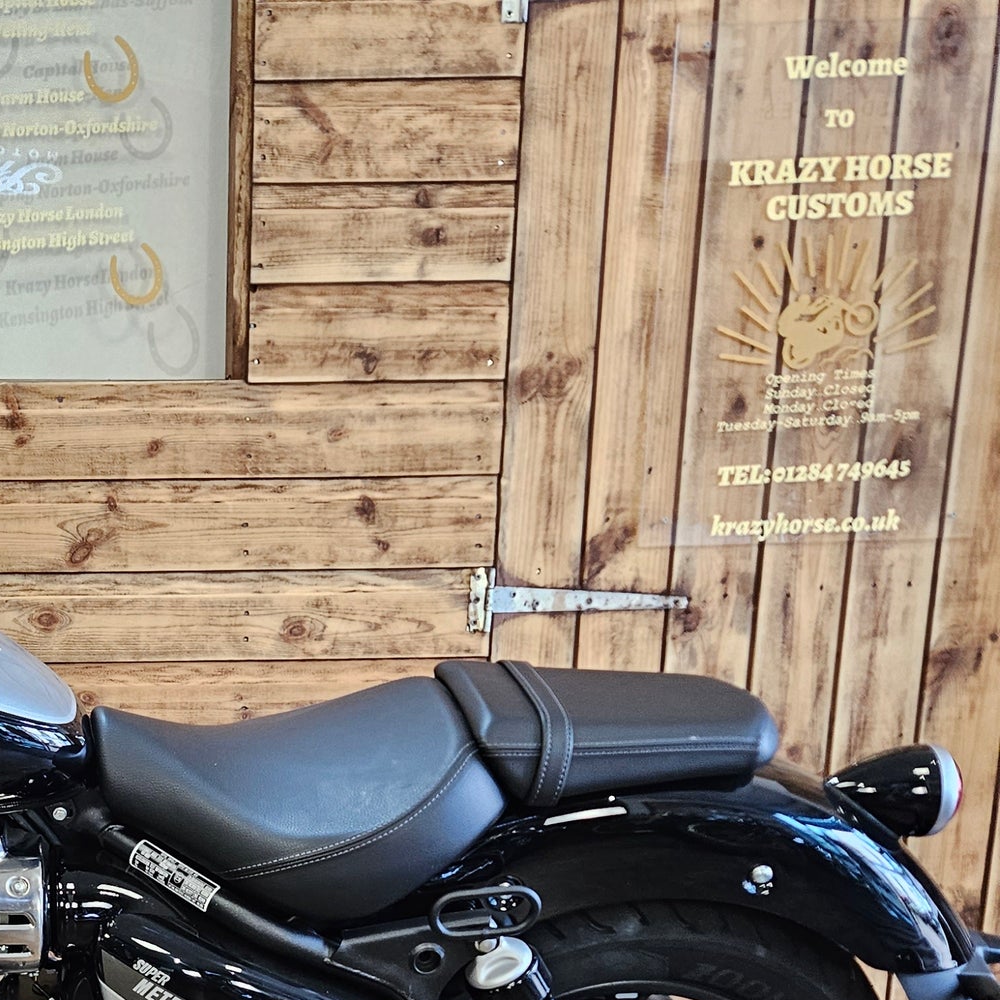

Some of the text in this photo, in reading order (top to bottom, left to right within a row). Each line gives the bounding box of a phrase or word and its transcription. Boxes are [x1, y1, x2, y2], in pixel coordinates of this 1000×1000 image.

[785, 51, 908, 80] Welcome
[36, 86, 86, 105] House
[2, 117, 159, 138] Norton-Oxfordshire
[824, 108, 855, 128] TO
[728, 152, 953, 187] KRAZY HORSE
[17, 208, 64, 223] Horse
[65, 203, 124, 221] London
[766, 190, 915, 221] CUSTOMS
[49, 231, 88, 252] High
[89, 228, 136, 246] Street
[765, 368, 876, 388] Opening Times
[836, 459, 912, 483] 749645
[710, 508, 901, 542] krazyhorse.co.uk
[132, 958, 172, 987] SUPER
